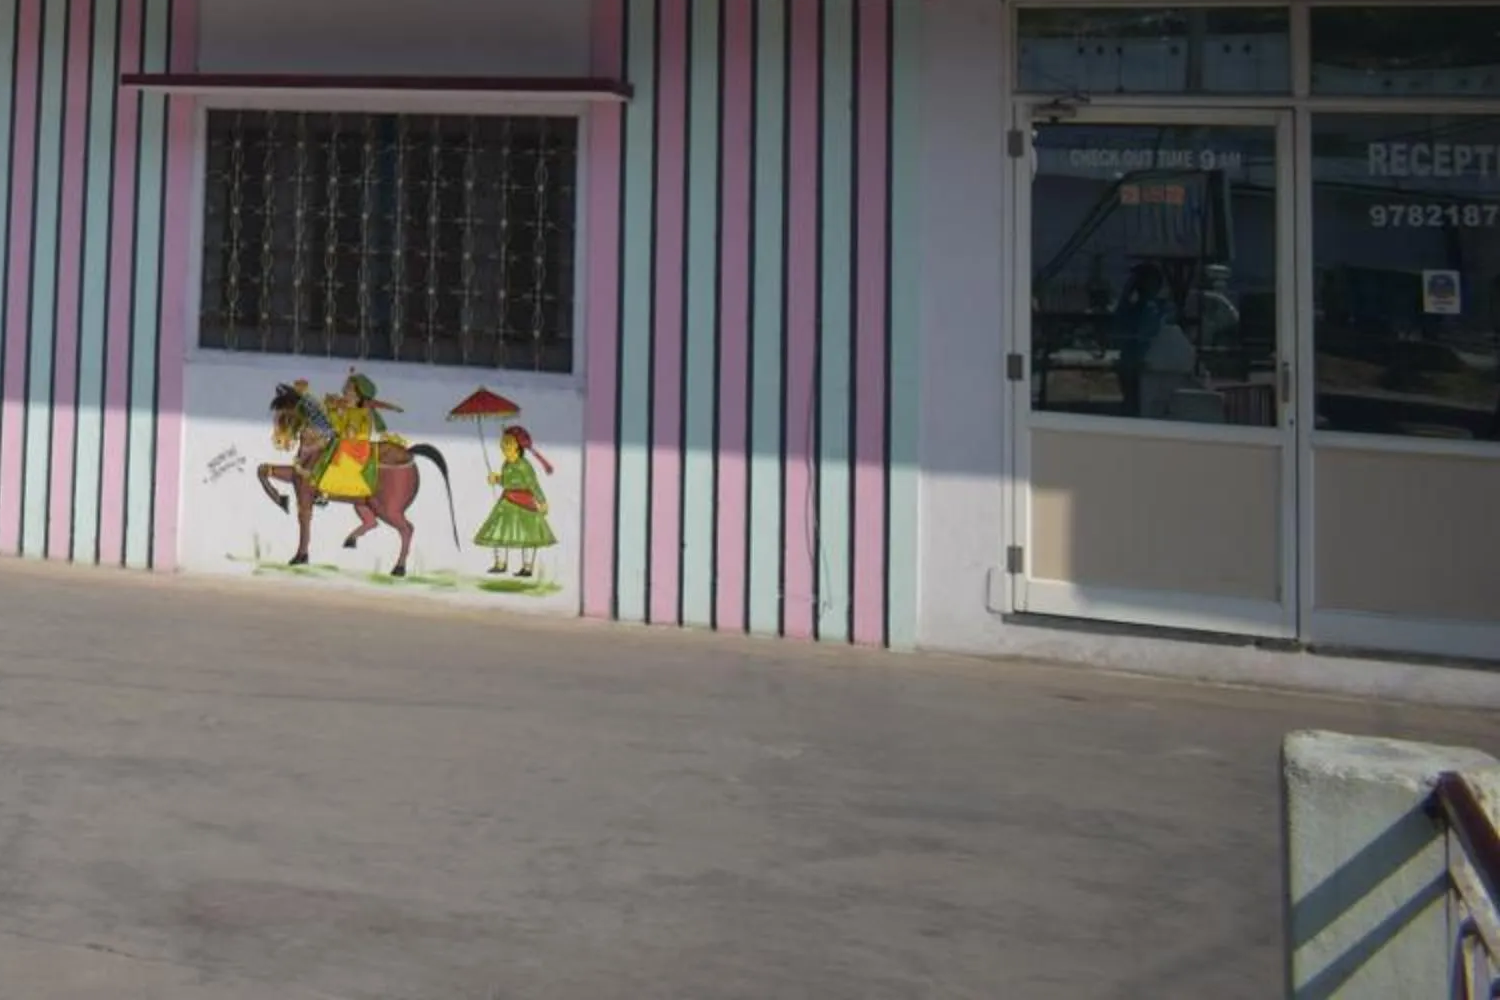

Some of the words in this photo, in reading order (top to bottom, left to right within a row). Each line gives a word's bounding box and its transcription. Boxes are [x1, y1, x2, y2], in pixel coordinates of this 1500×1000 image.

[1069, 149, 1120, 169] CHECK
[1122, 149, 1153, 168] OUT
[1156, 149, 1194, 168] TIME
[1199, 149, 1216, 171] 9
